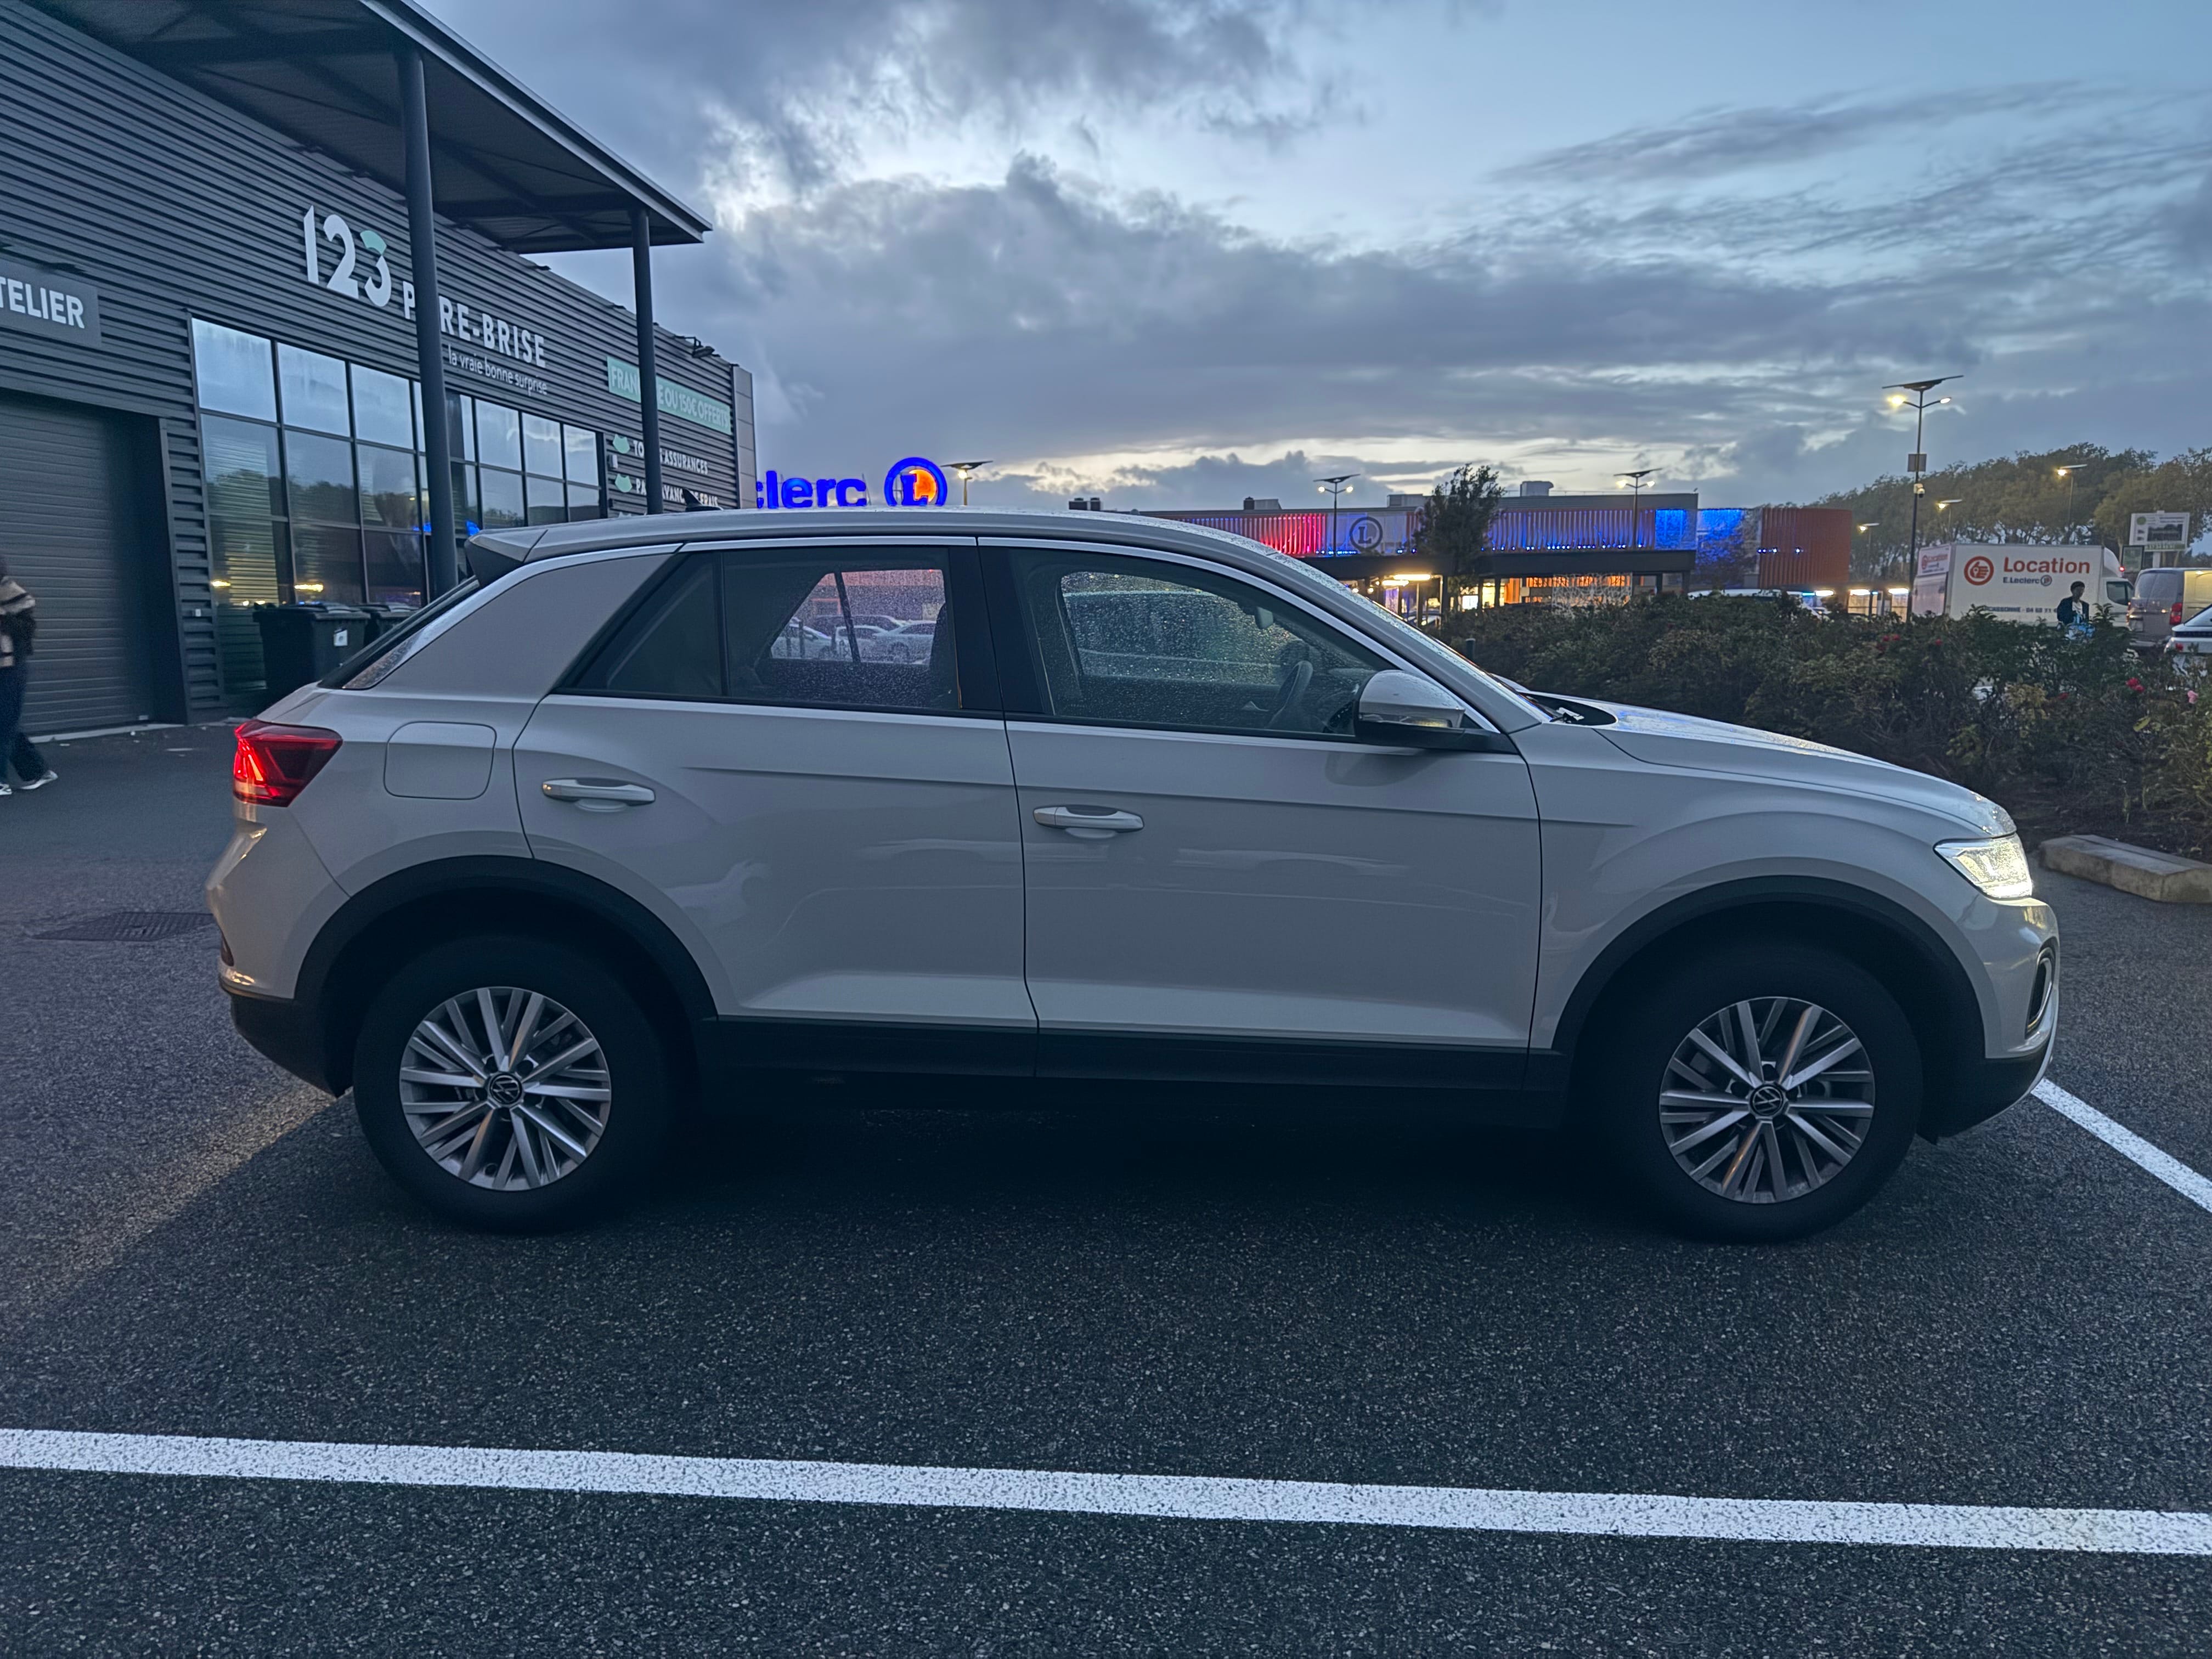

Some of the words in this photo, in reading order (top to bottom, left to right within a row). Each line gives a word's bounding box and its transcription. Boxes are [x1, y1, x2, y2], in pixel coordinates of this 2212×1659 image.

[303, 205, 391, 307] 123
[403, 280, 546, 368] PRE-BRISE
[448, 343, 458, 366] la
[460, 353, 483, 375] vraie
[484, 357, 514, 384] bonne
[515, 374, 548, 396] surprise
[611, 365, 664, 405] FRANE
[665, 387, 679, 410] OU
[679, 393, 698, 417] 150€
[664, 449, 709, 475] ASSURANCES
[756, 470, 867, 509] lerc
[2004, 556, 2090, 574] Location
